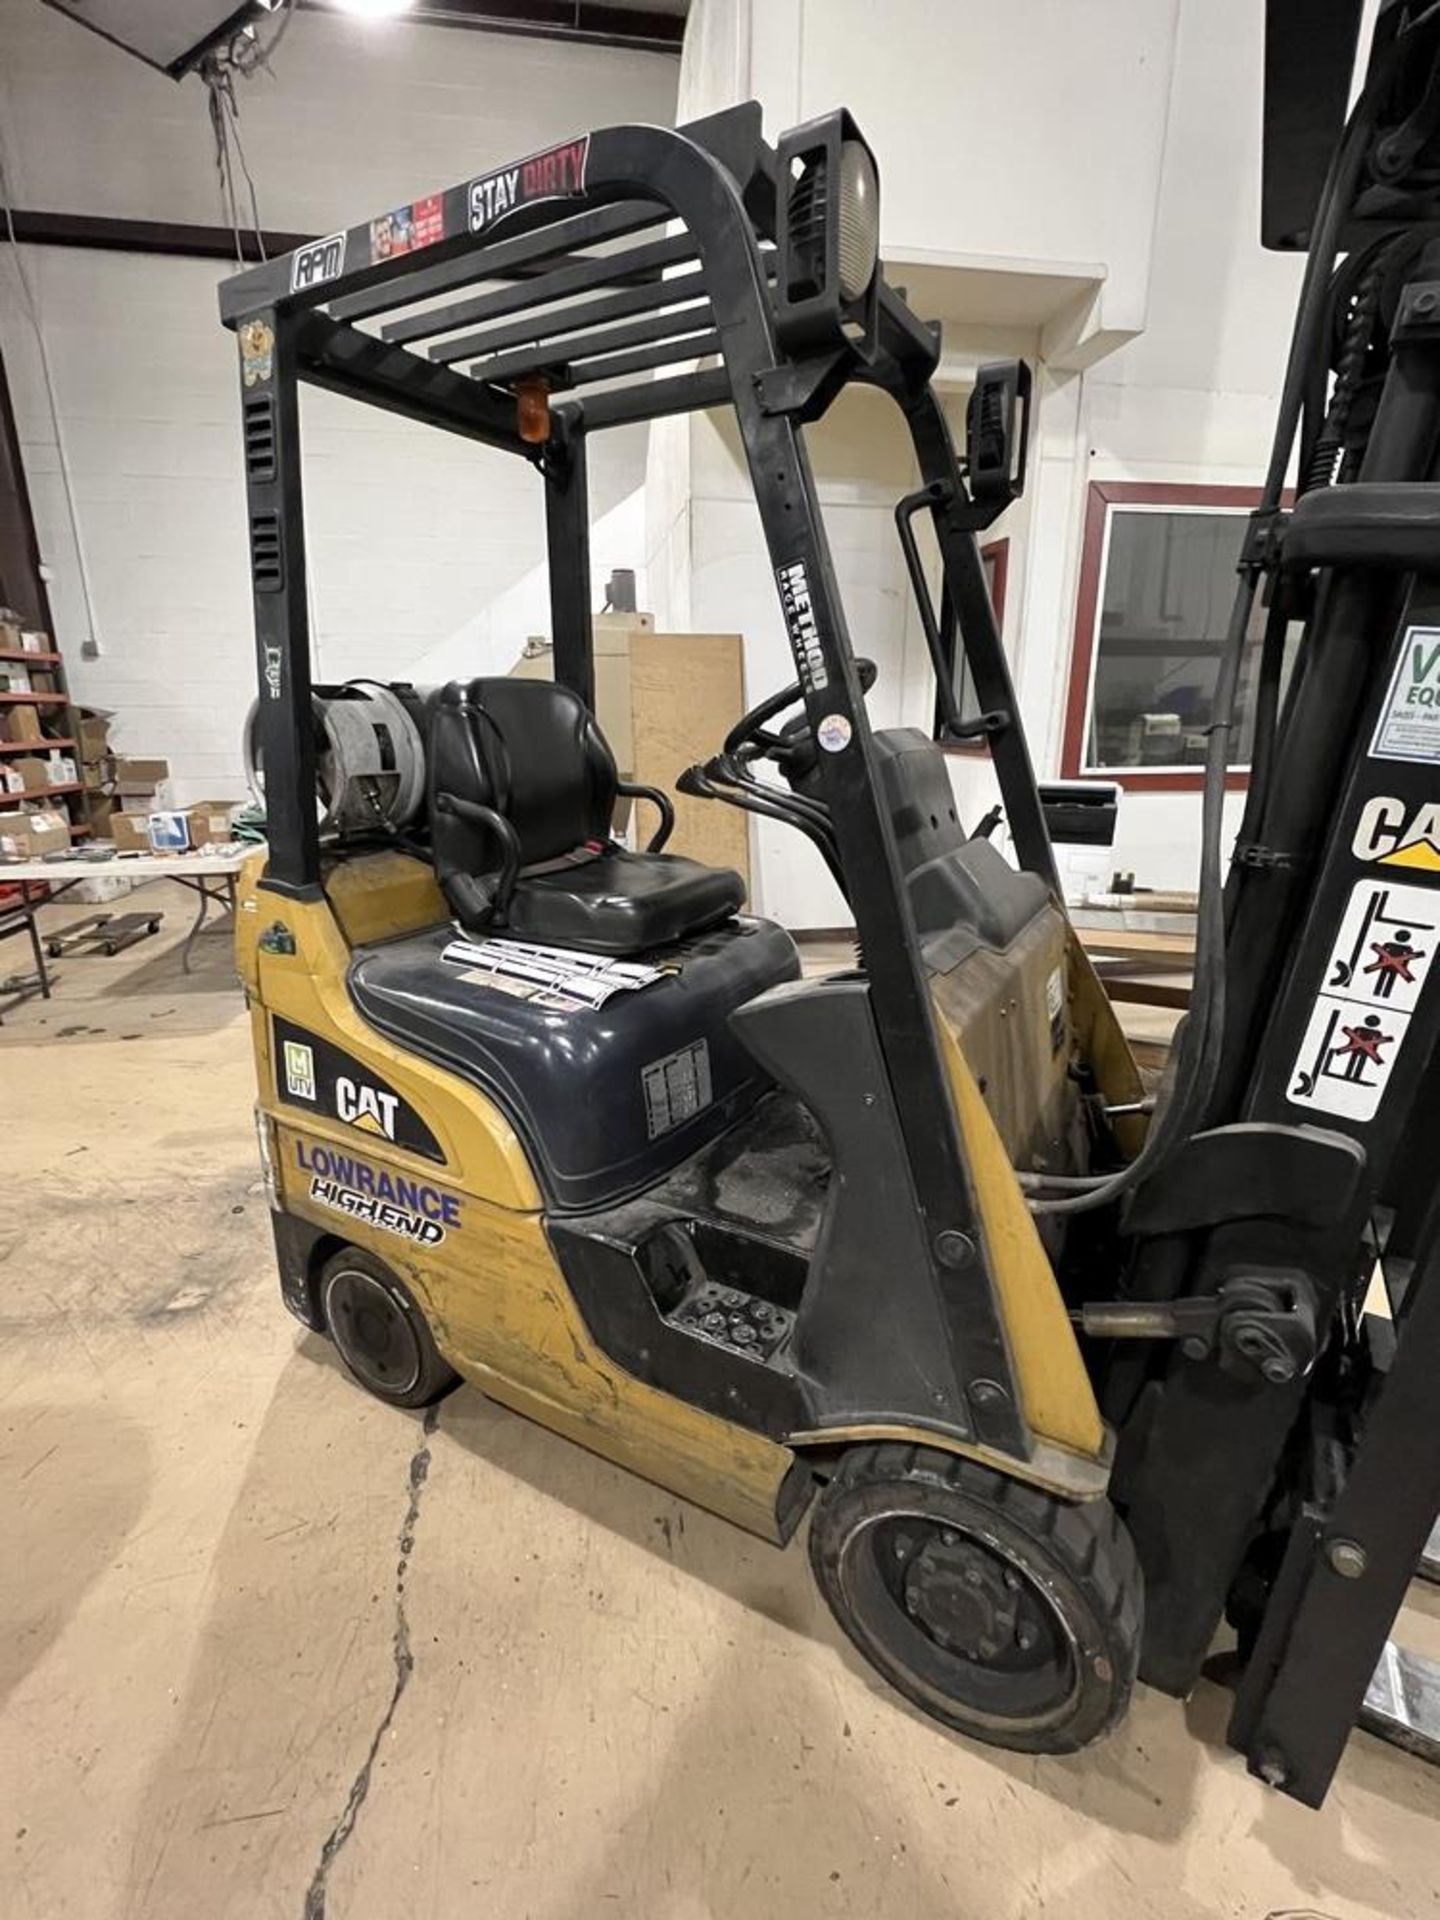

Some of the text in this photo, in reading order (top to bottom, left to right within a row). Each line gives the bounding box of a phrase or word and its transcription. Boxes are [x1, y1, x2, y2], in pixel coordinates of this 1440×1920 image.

[471, 169, 520, 231] STAY
[523, 142, 584, 197] DIRTY
[296, 244, 341, 287] RPM
[779, 569, 814, 694] RACE WHEELS
[789, 563, 829, 691] METHOD
[1412, 643, 1440, 684] V
[289, 1075, 313, 1096] UTV
[336, 1076, 399, 1141] CAT
[296, 1140, 462, 1229] LOWRANCE
